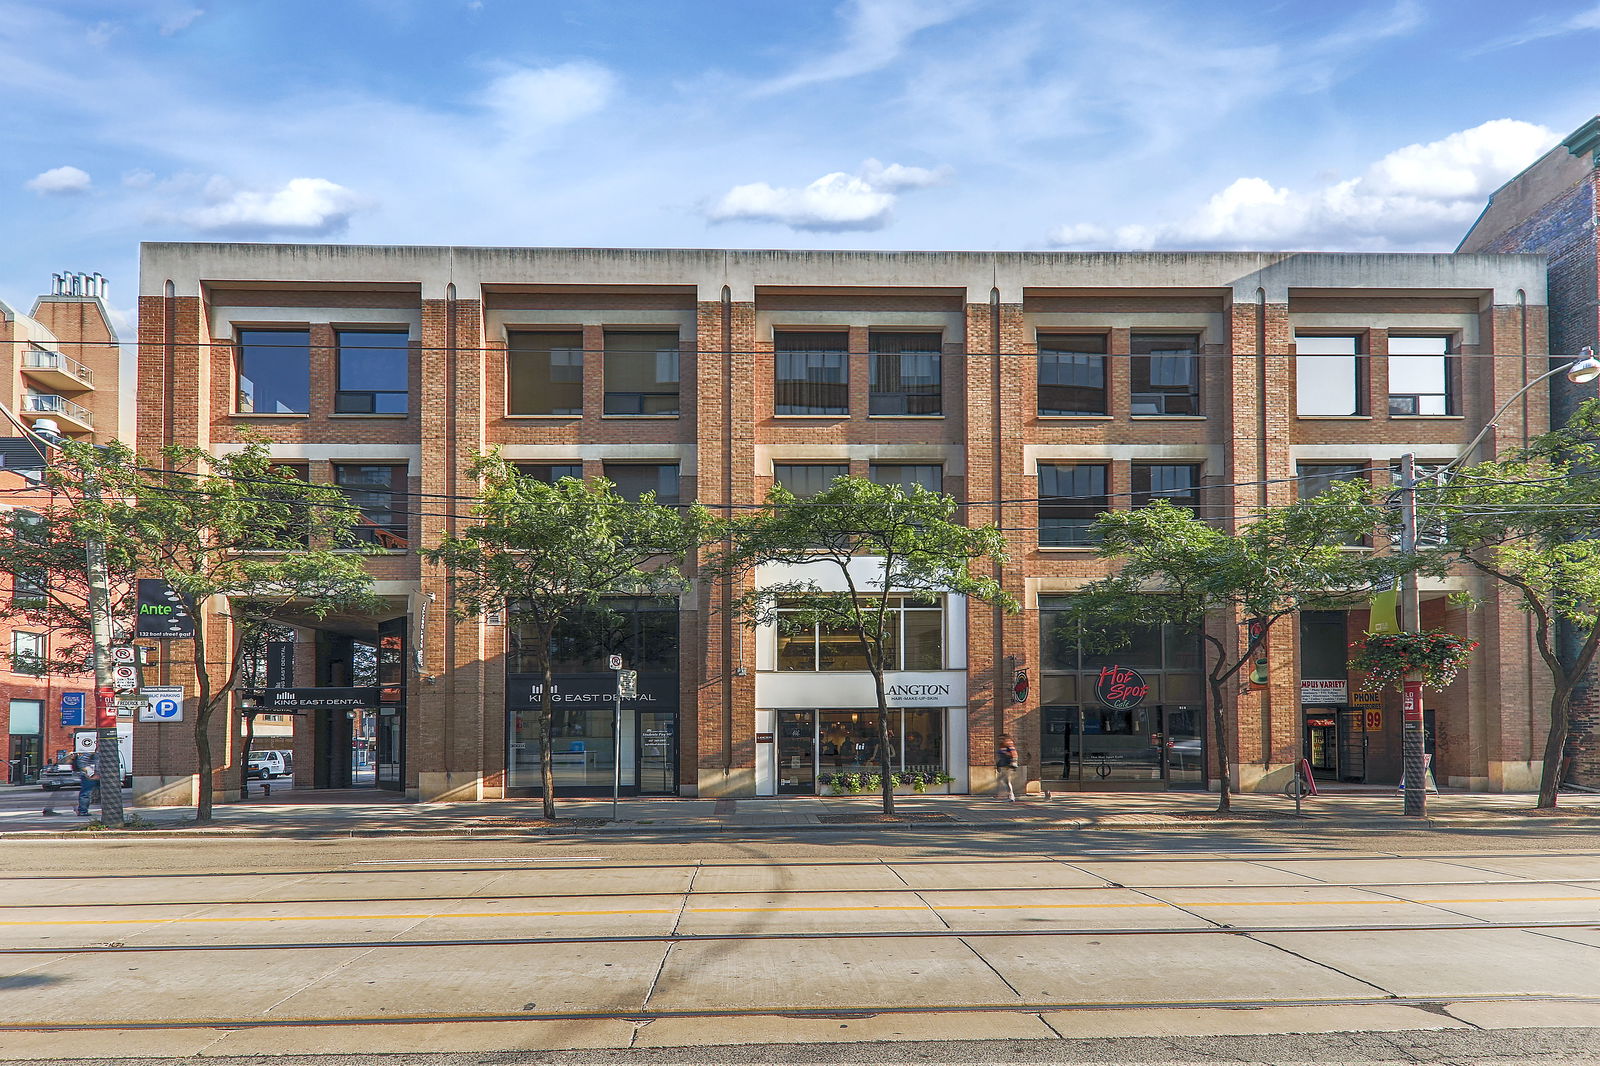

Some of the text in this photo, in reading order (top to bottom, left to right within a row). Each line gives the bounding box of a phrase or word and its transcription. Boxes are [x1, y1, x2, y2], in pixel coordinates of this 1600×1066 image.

[140, 604, 172, 614] Ante
[1099, 665, 1134, 686] Hot
[884, 685, 950, 695] ANGTON
[1107, 684, 1150, 700] Spot
[529, 694, 562, 702] KIG
[1354, 693, 1379, 702] PHONE
